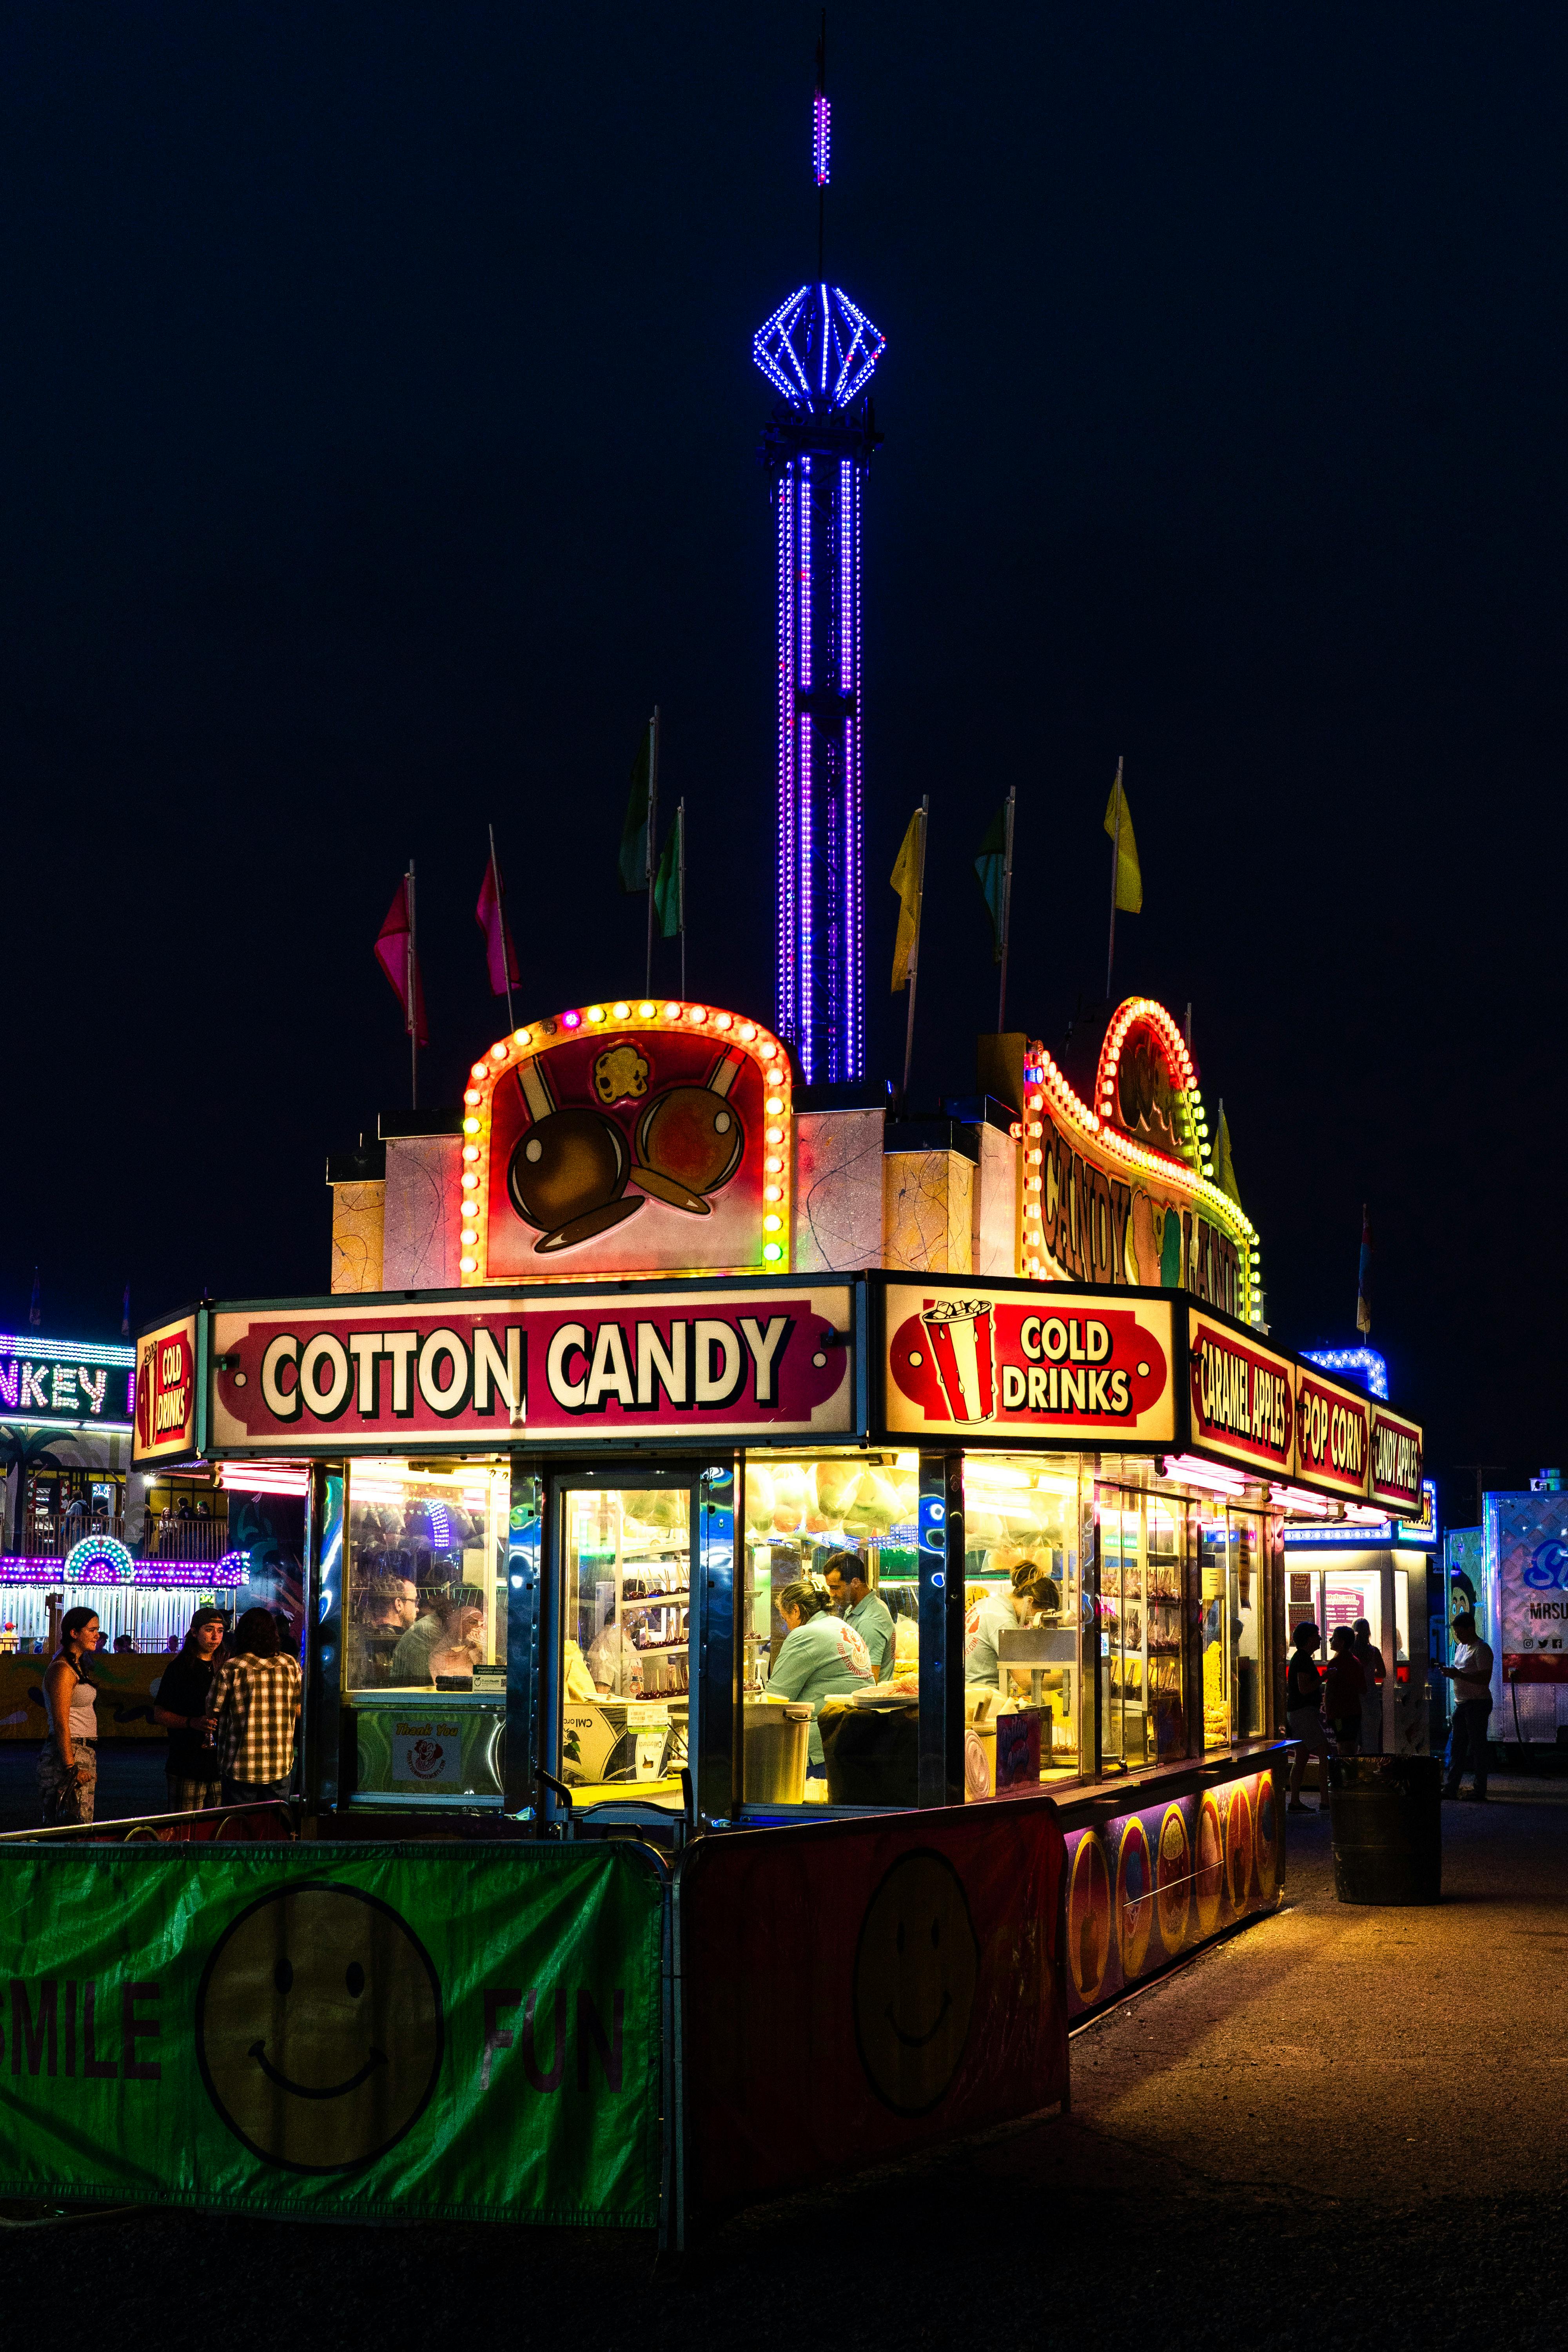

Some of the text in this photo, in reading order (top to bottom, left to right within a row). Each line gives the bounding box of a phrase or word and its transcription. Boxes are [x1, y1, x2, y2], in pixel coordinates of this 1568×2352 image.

[1040, 1114, 1131, 1284] CANDY
[163, 1344, 182, 1388] COLD
[261, 1315, 796, 1421] COTTON CANDY
[1020, 1315, 1113, 1365] COLD
[157, 1387, 185, 1434] DRINKS
[1002, 1365, 1133, 1416] DRINKS
[1201, 1337, 1286, 1454] CARAMEL APPLES
[1303, 1389, 1363, 1478] POP CORN
[1375, 1423, 1417, 1495] CANDY APPLES
[396, 1722, 458, 1736] Thank You
[0, 1980, 161, 2080] MILE
[479, 1989, 625, 2093] FUN
